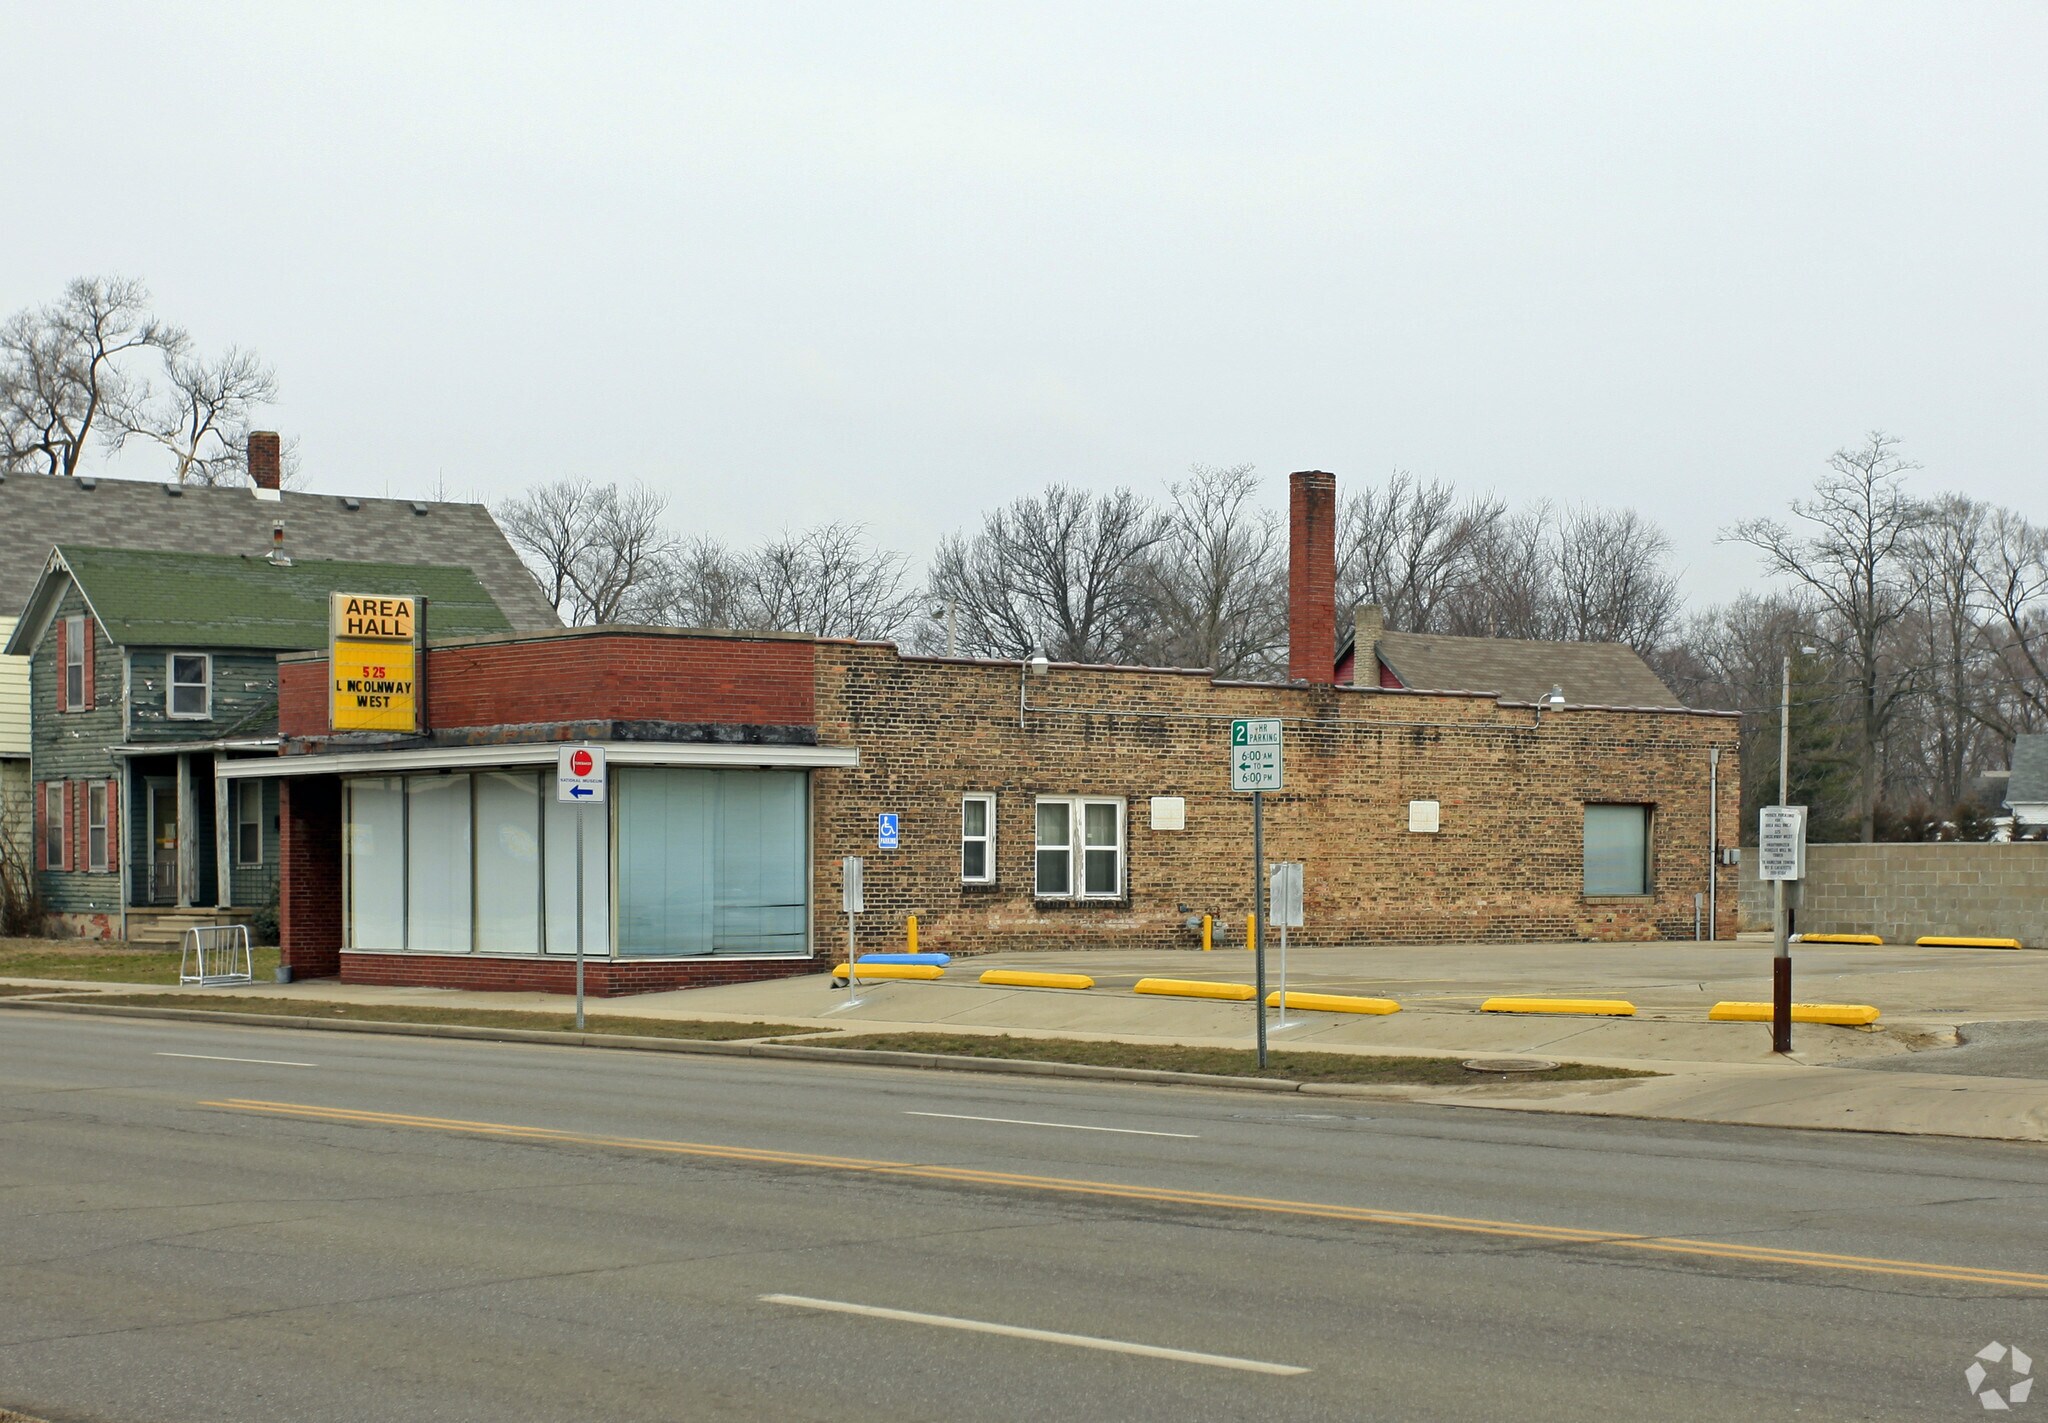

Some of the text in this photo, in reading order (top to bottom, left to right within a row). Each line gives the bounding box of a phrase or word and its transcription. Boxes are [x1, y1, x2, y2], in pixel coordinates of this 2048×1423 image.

[346, 599, 410, 618] AREA
[348, 618, 407, 636] HALL
[357, 696, 390, 708] WEST
[1236, 724, 1267, 742] 2 HR
[1249, 733, 1277, 742] PARKING
[1242, 751, 1272, 761] 6:00 AM
[1242, 772, 1262, 783] 6:00
